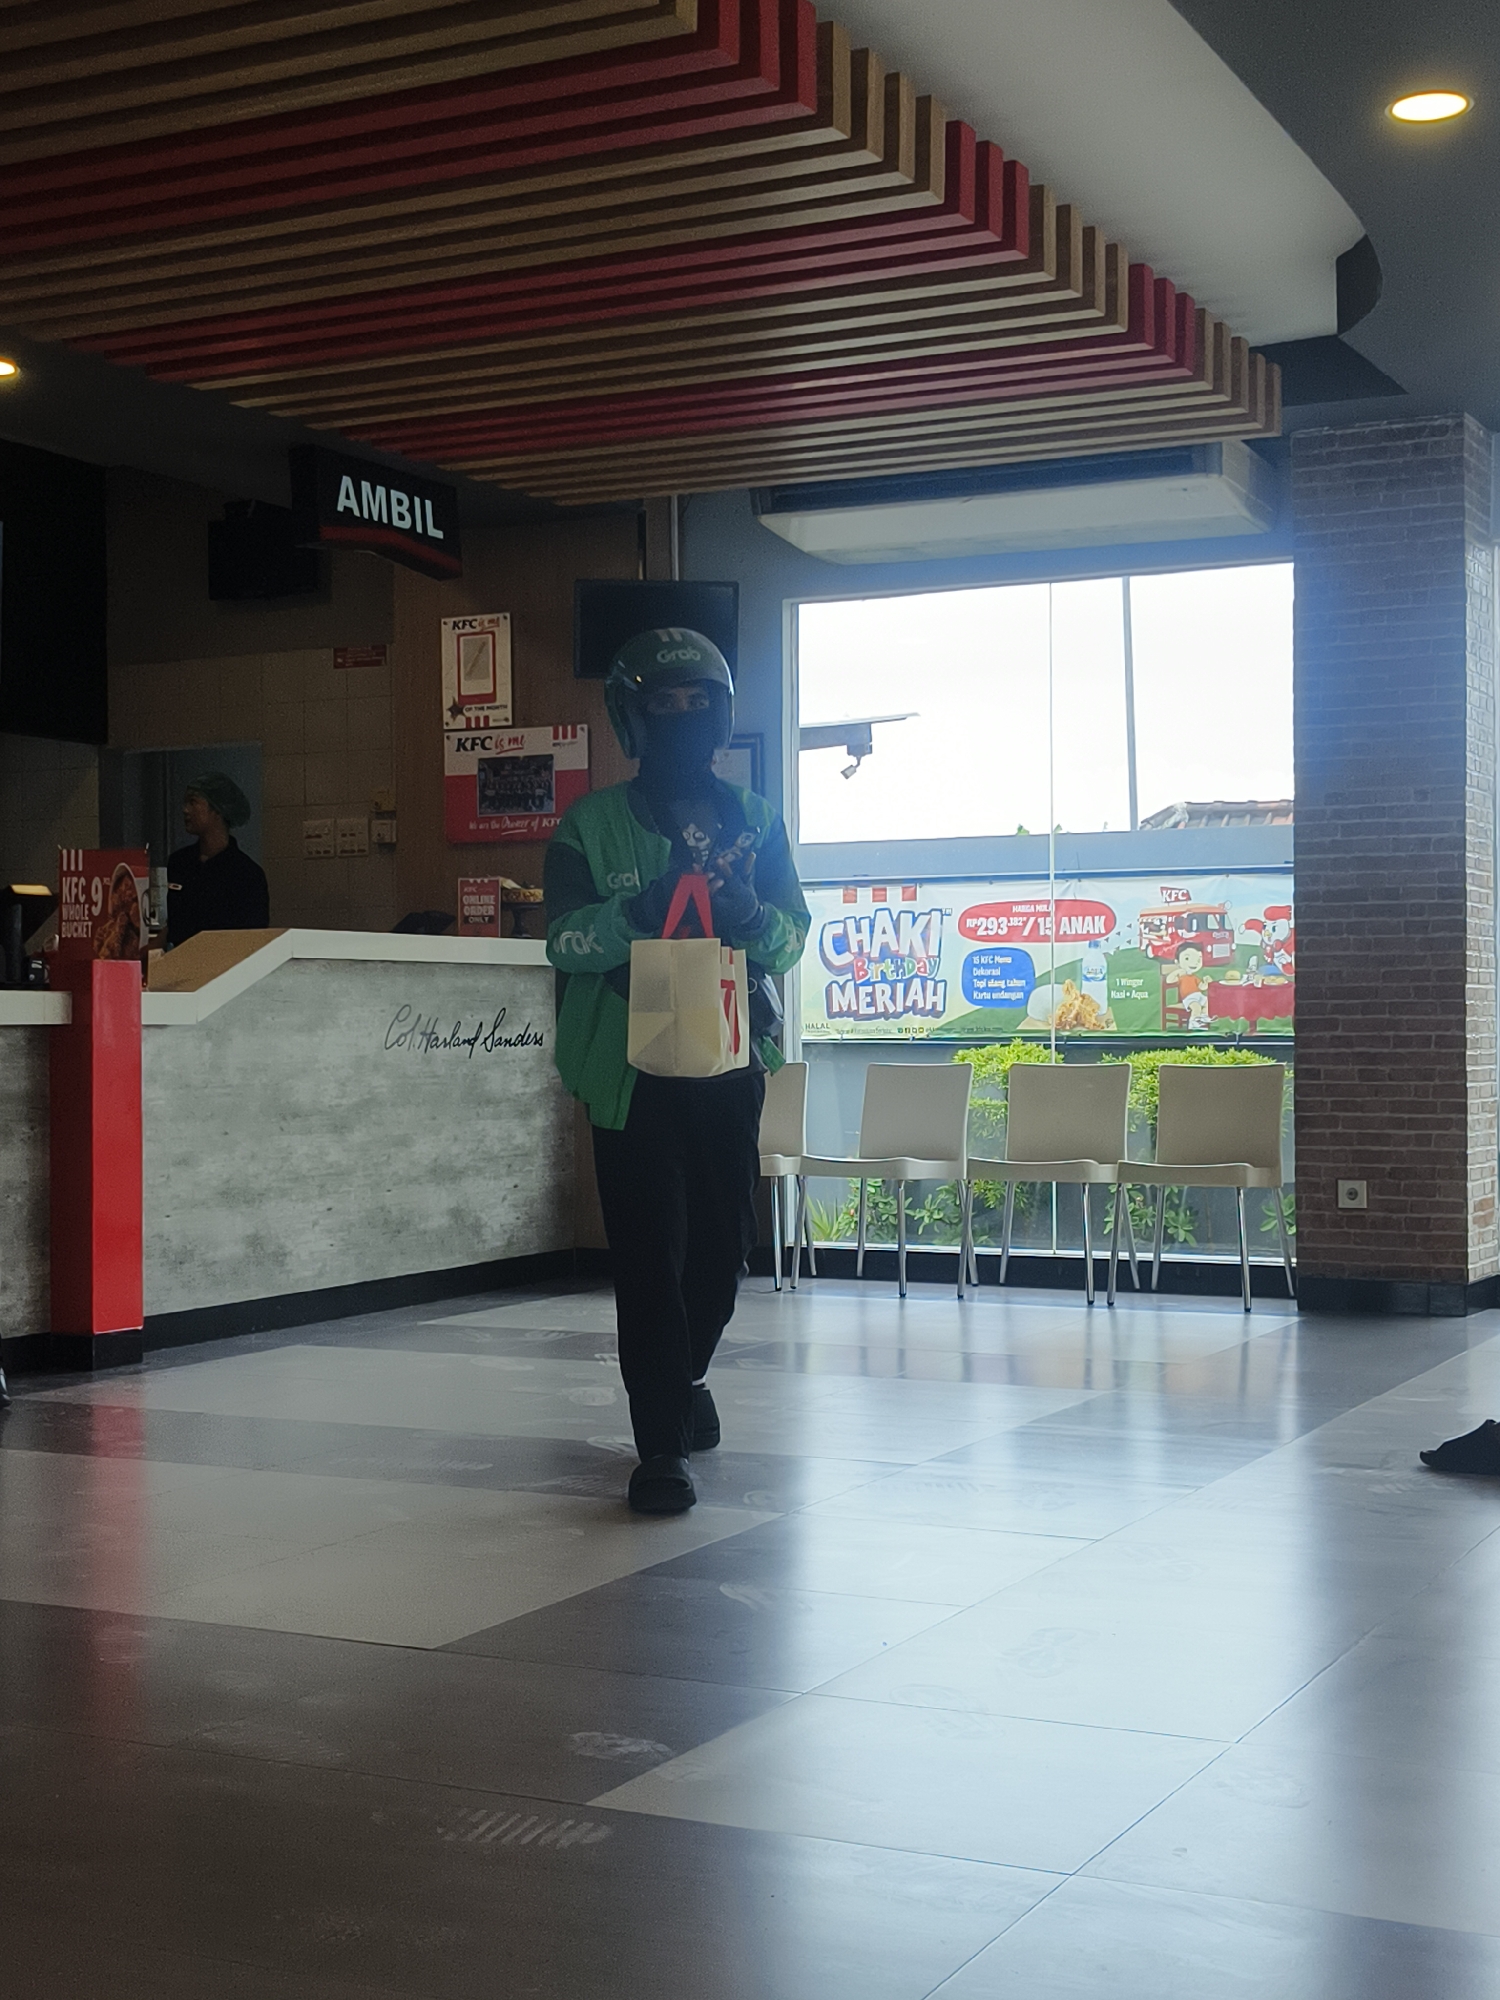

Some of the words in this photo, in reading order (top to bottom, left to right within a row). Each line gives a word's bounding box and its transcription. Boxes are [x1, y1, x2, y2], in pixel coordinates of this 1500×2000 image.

[337, 475, 444, 539] AMBIL
[452, 619, 478, 630] KFC
[656, 646, 701, 663] Grab
[456, 735, 493, 752] KFC
[62, 876, 86, 903] KFC
[91, 876, 103, 917] 9
[462, 895, 496, 905] ONLINE
[1162, 889, 1187, 902] KFC
[62, 903, 89, 921] WHOLE
[463, 905, 495, 916] ORDER
[61, 921, 93, 938] BUCKET
[1059, 915, 1106, 935] ANAK
[820, 907, 943, 967] CHAKI
[980, 954, 994, 964] KFC
[827, 977, 947, 1017] MERIAH
[480, 1007, 544, 1052] Sanders
[805, 1022, 831, 1030] HALAL
